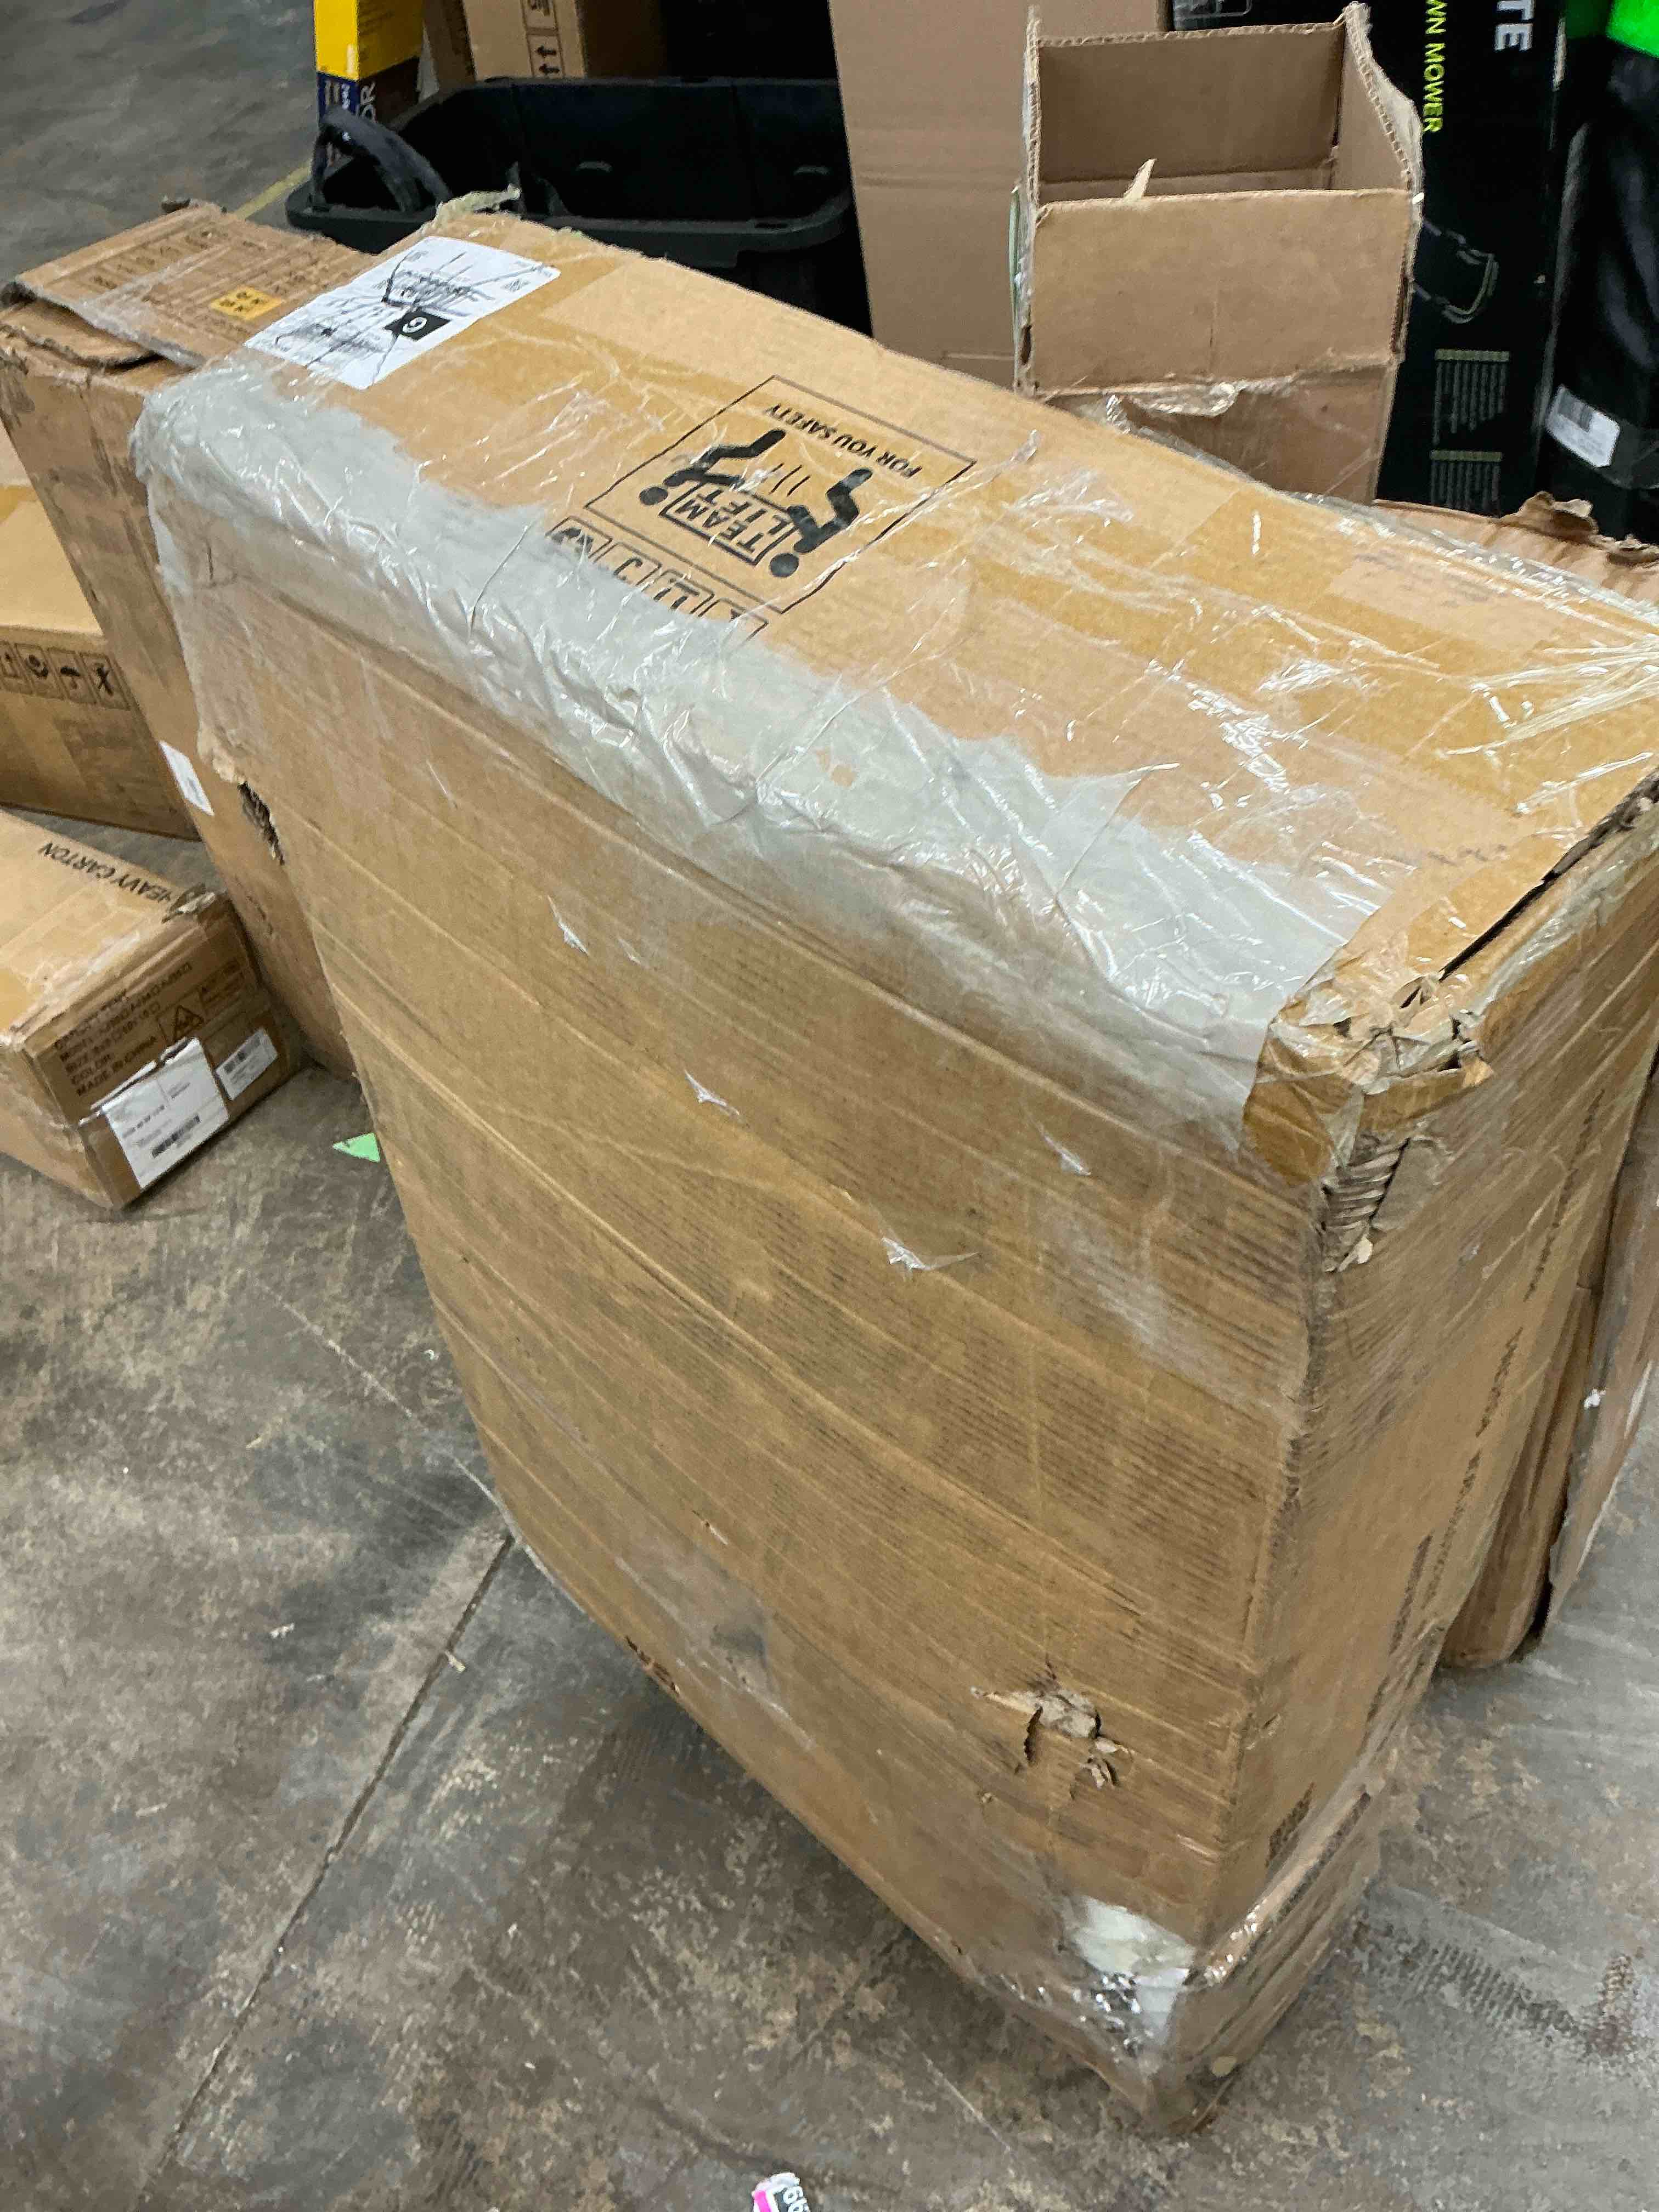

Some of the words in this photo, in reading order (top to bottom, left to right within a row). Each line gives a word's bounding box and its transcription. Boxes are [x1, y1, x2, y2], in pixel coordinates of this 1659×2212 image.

[1423, 43, 1446, 132] MOWER
[765, 403, 837, 439] SAFETY
[832, 433, 878, 459] YOU
[876, 451, 922, 479] FOR
[675, 499, 766, 554] TEAM
[696, 489, 790, 535] LIFT
[38, 842, 116, 879] CARTON
